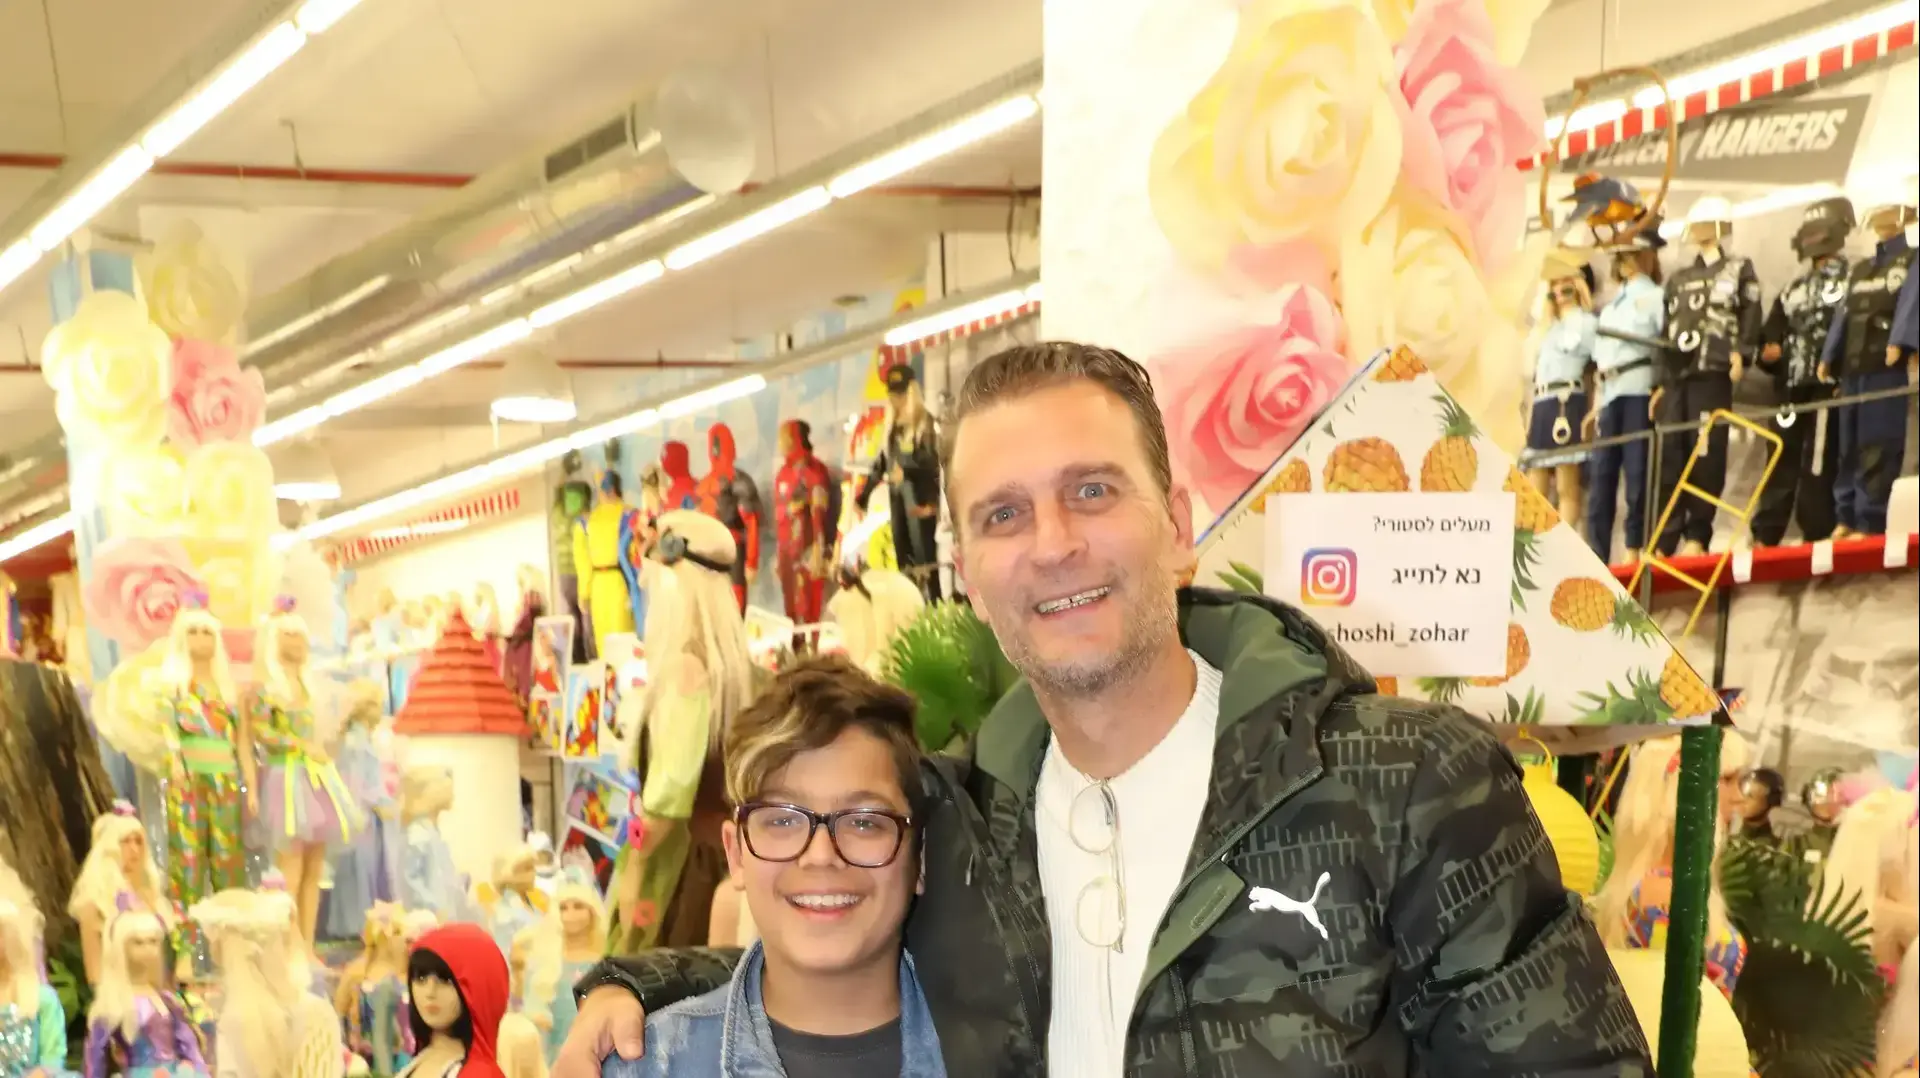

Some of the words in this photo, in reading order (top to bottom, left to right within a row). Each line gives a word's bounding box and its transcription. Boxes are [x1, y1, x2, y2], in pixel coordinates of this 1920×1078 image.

[1373, 515, 1435, 532] לסטורי?
[1441, 515, 1491, 532] מעלים
[1391, 563, 1447, 585] לתייג
[1456, 567, 1482, 584] נא
